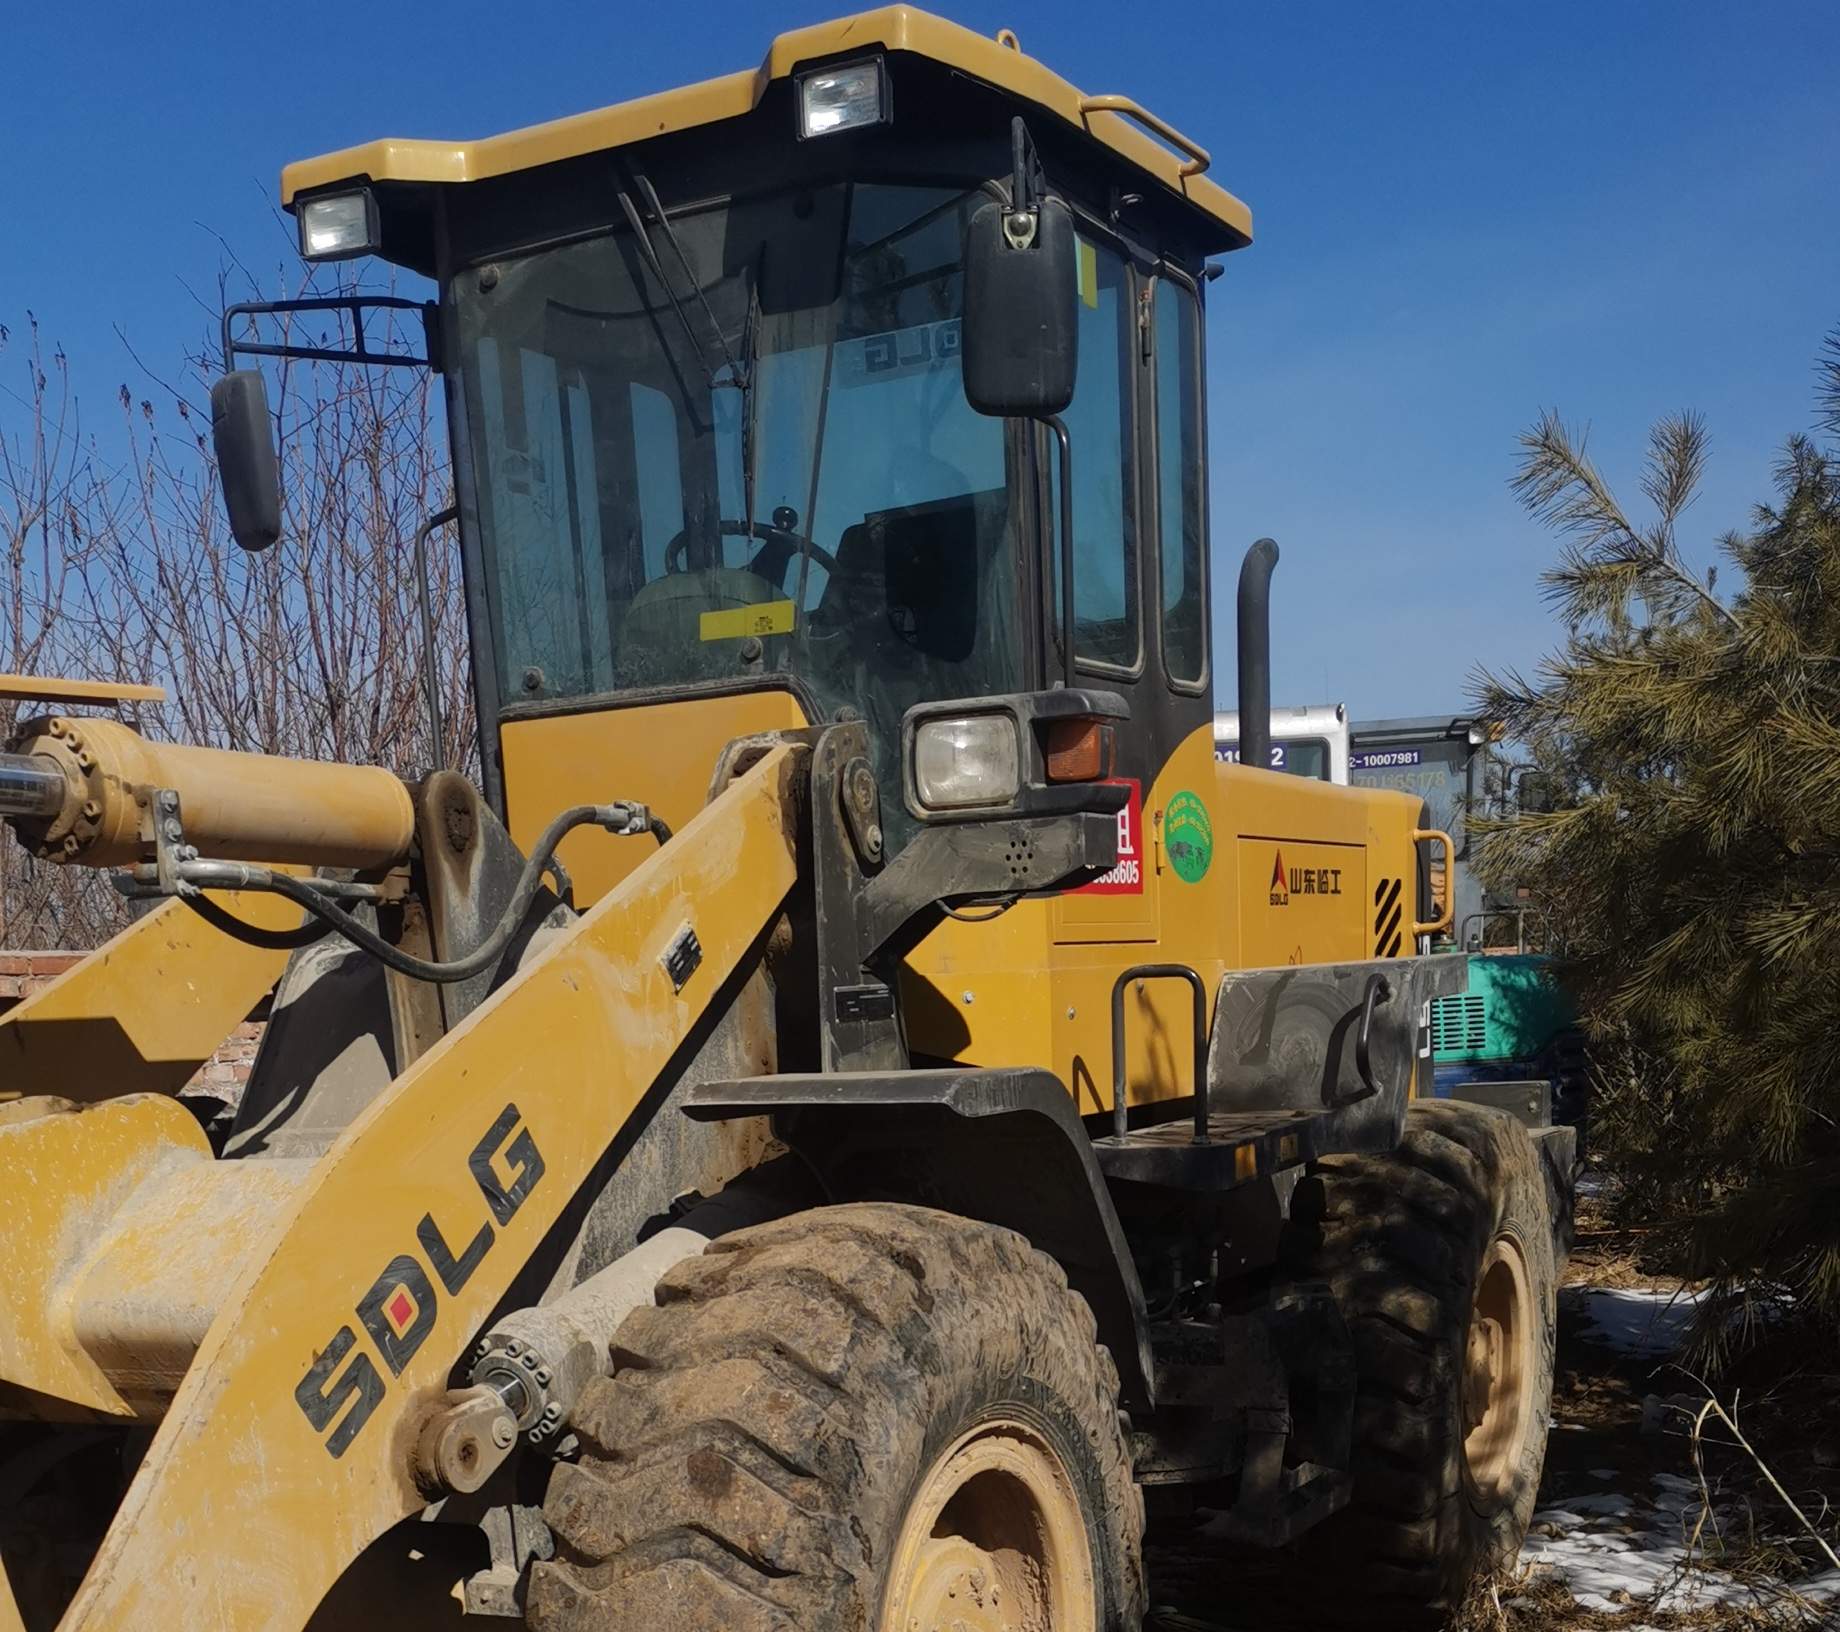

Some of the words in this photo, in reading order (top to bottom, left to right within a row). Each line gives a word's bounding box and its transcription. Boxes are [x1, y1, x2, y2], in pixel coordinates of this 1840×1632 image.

[1290, 867, 1341, 894] 山东临工
[295, 1102, 546, 1459] SDLG
